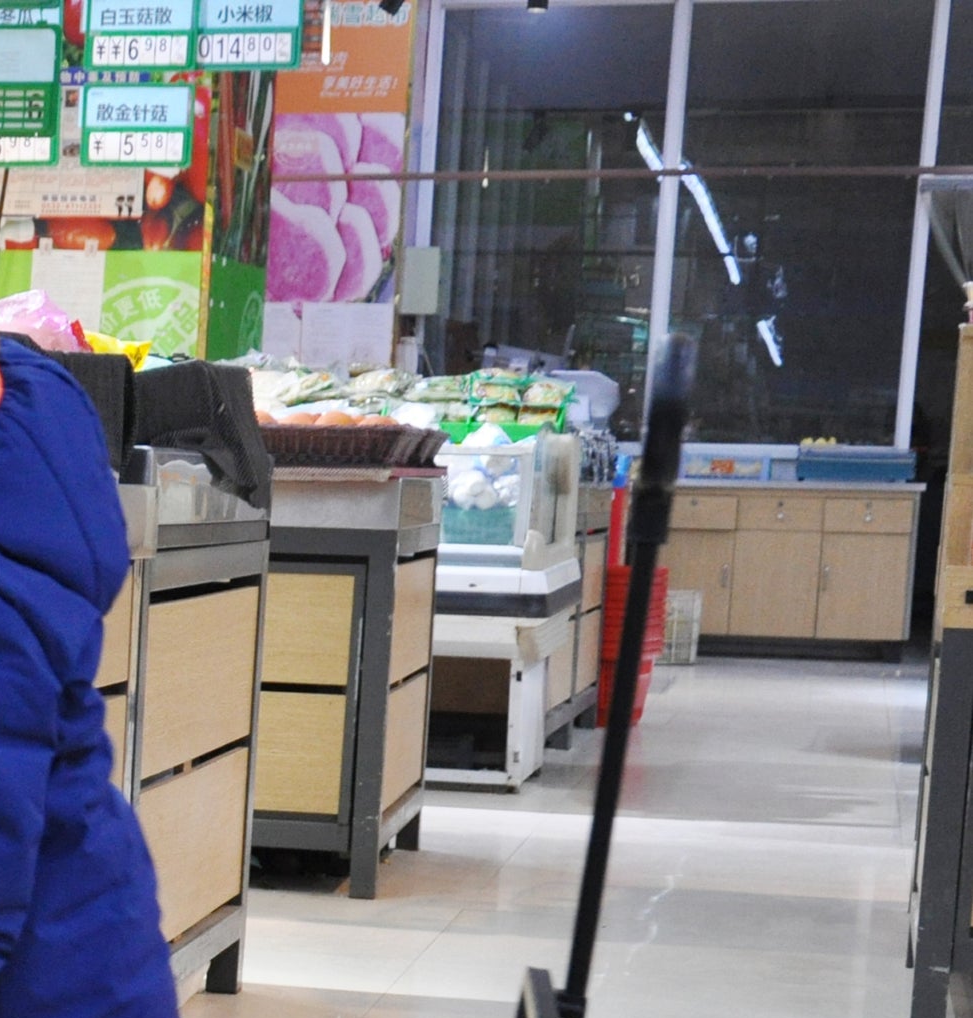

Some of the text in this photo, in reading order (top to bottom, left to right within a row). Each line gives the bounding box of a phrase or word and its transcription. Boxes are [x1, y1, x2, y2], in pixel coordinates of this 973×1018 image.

[100, 8, 173, 27] 白玉菇散
[218, 5, 274, 24] 小米椒
[96, 103, 169, 123] 散金针菇
